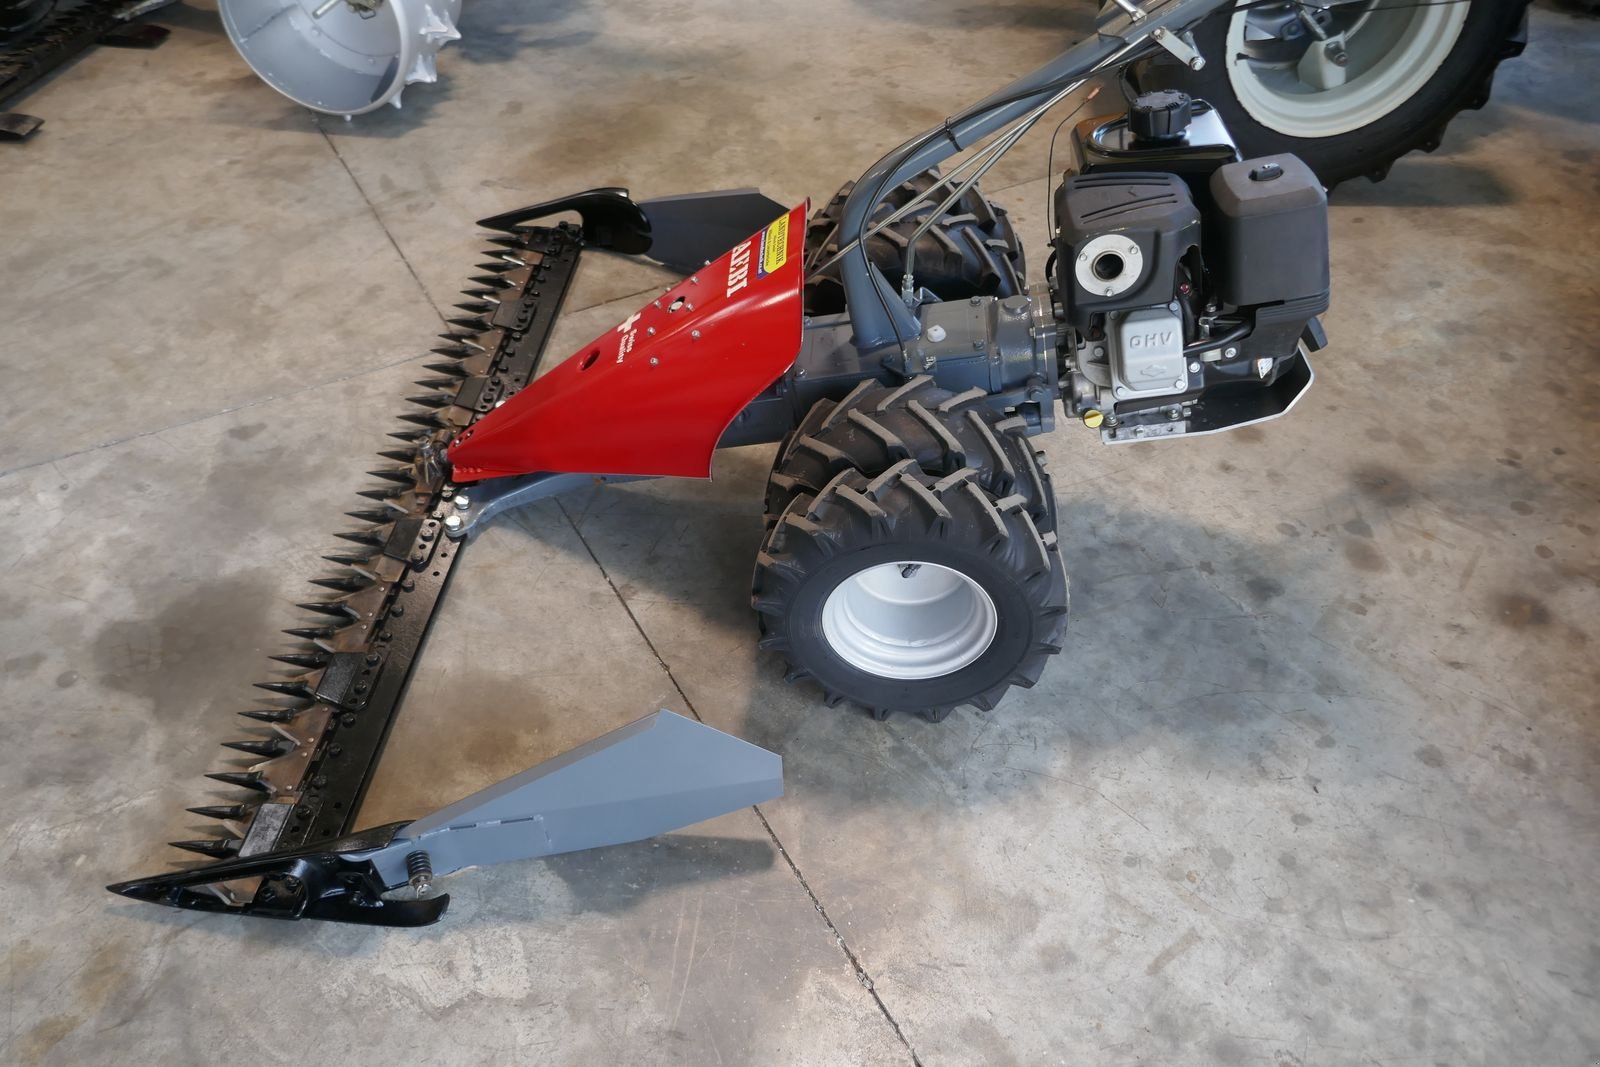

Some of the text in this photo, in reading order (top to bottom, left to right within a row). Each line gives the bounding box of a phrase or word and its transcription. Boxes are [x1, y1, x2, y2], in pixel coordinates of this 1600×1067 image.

[726, 240, 751, 298] AEBI
[616, 334, 629, 363] Quality
[626, 329, 637, 352] Swiss
[1129, 331, 1173, 349] OHV
